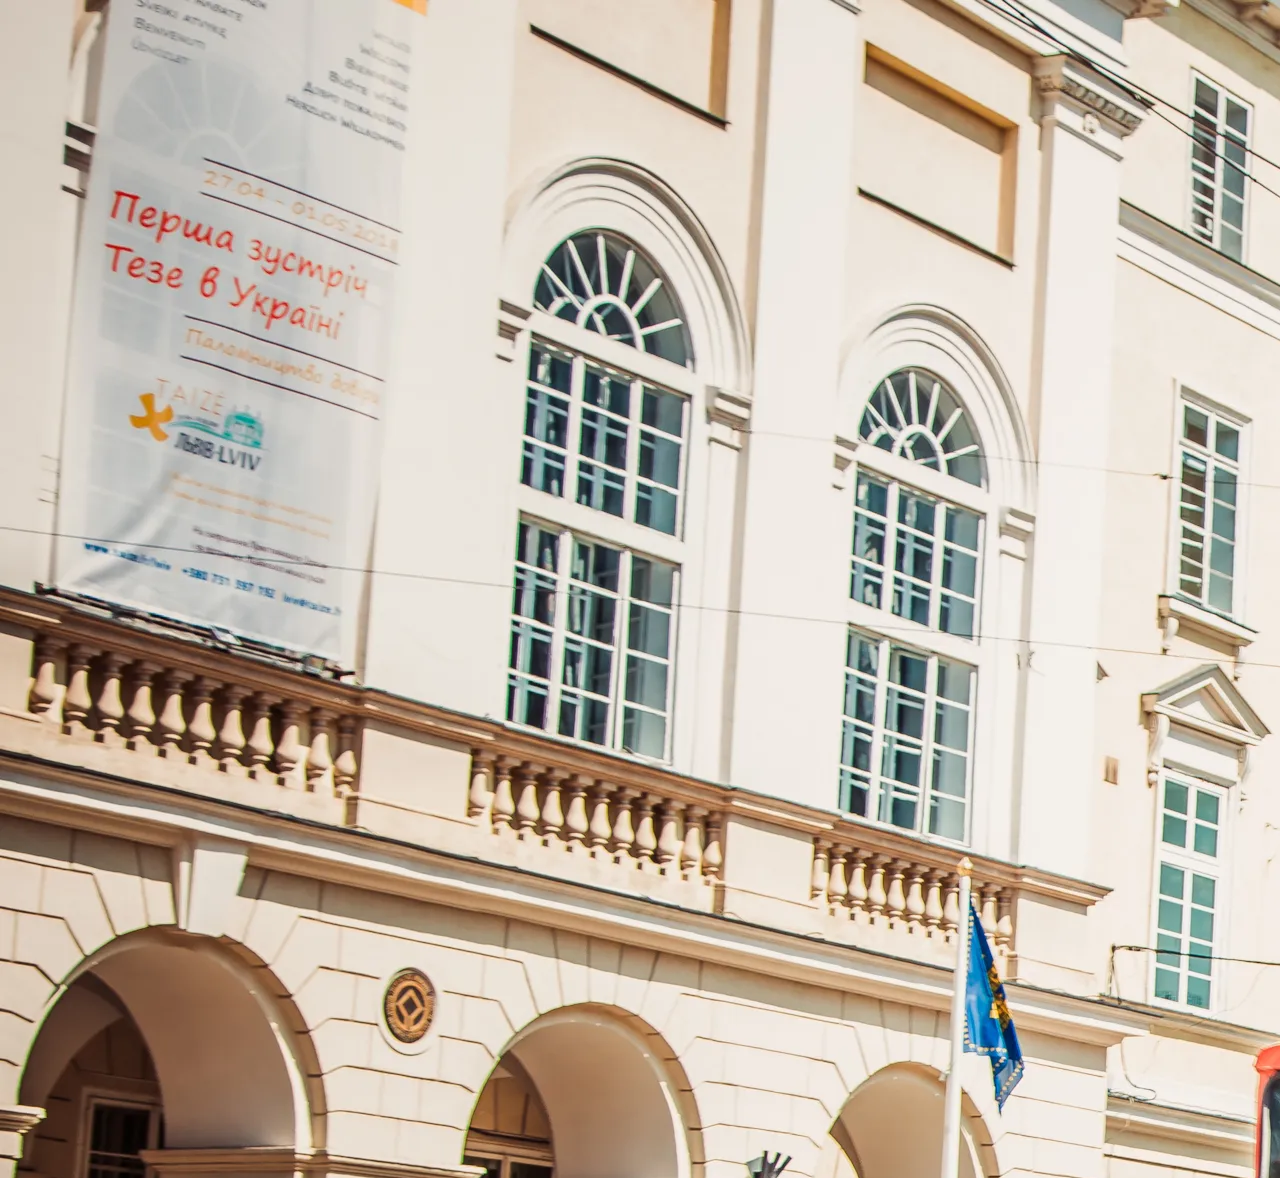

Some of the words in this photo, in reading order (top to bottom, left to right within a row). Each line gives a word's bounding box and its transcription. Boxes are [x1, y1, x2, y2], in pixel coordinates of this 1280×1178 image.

[104, 243, 184, 289] Тезе
[200, 265, 220, 299] в
[228, 276, 345, 340] Україні
[109, 190, 234, 252] Перша
[247, 239, 368, 299] зустріч
[155, 378, 227, 417] TAIZÉ
